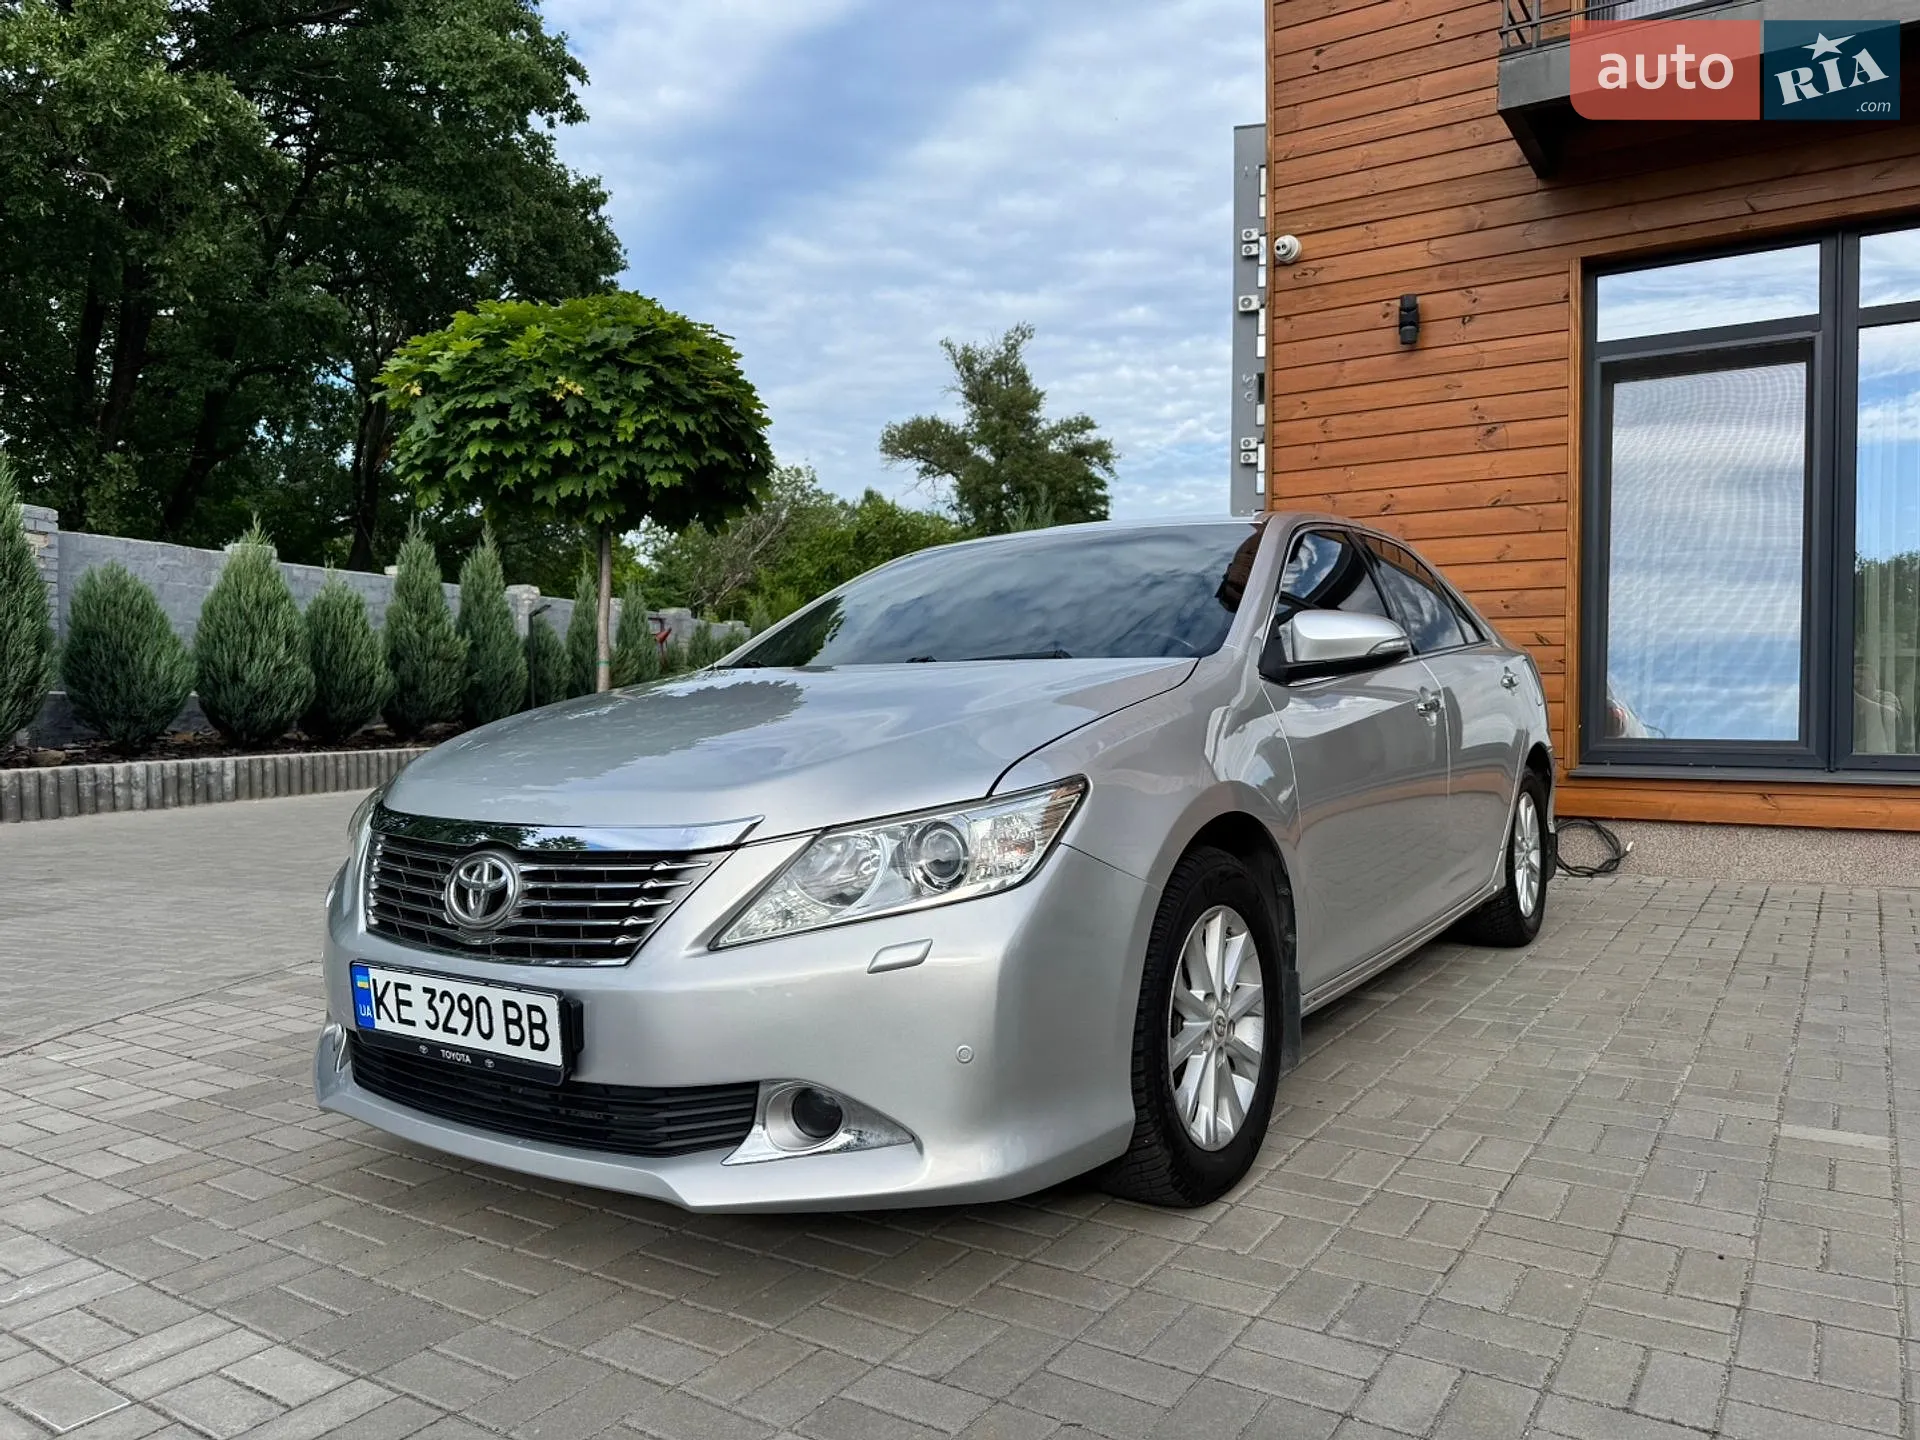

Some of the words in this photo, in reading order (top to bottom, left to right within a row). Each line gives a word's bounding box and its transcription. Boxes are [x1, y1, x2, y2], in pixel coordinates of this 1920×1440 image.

[359, 1003, 373, 1019] UA
[372, 977, 416, 1027] KE
[422, 987, 494, 1041] 3290
[502, 999, 550, 1052] BB
[440, 1049, 472, 1065] TOYOTA
